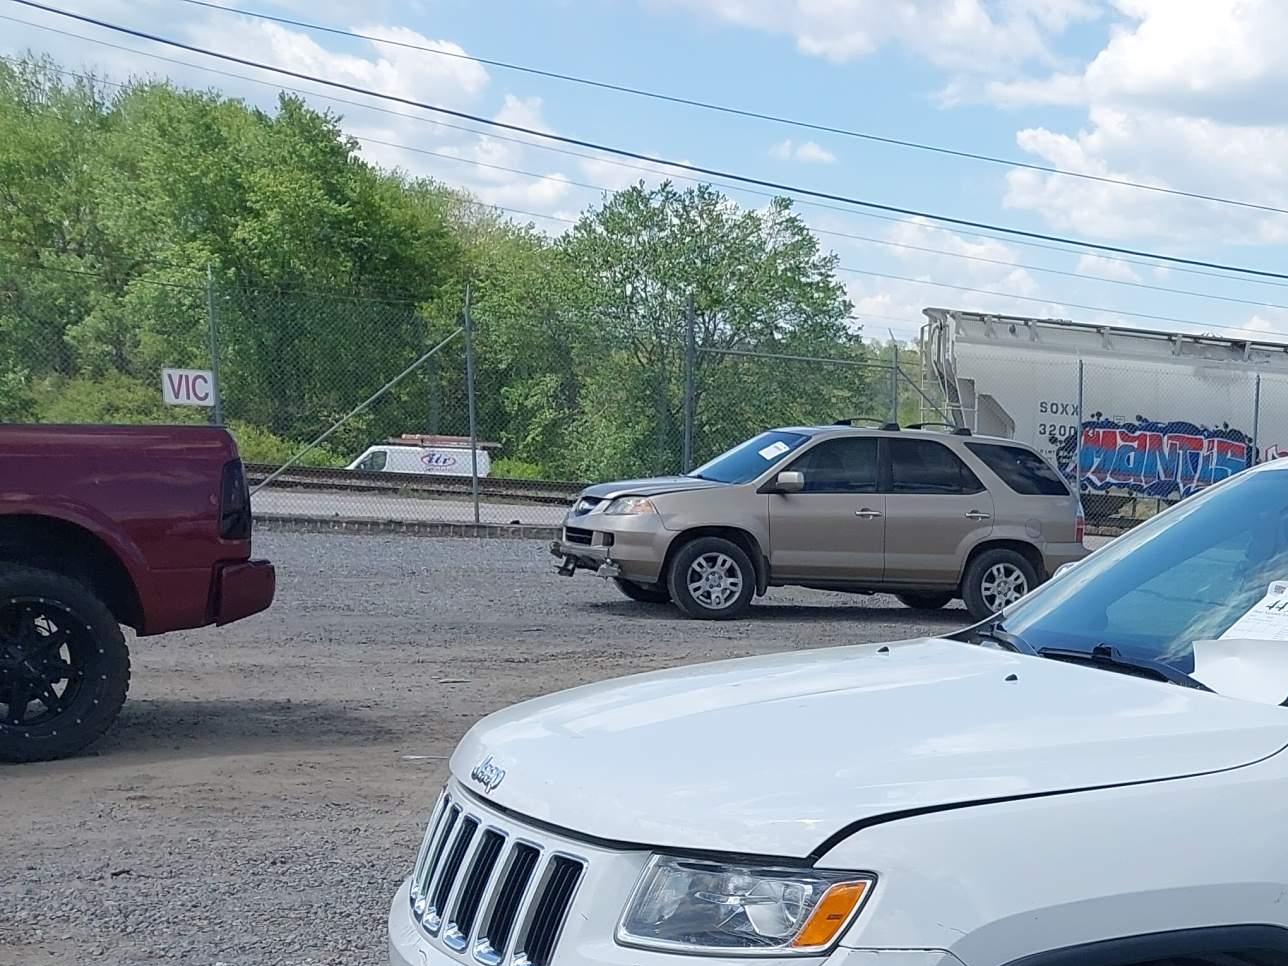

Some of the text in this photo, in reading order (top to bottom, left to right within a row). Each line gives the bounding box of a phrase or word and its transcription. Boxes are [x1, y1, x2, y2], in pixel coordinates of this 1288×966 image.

[167, 373, 209, 401] VIC
[1039, 401, 1079, 416] SOXX
[471, 753, 506, 794] Jeep
